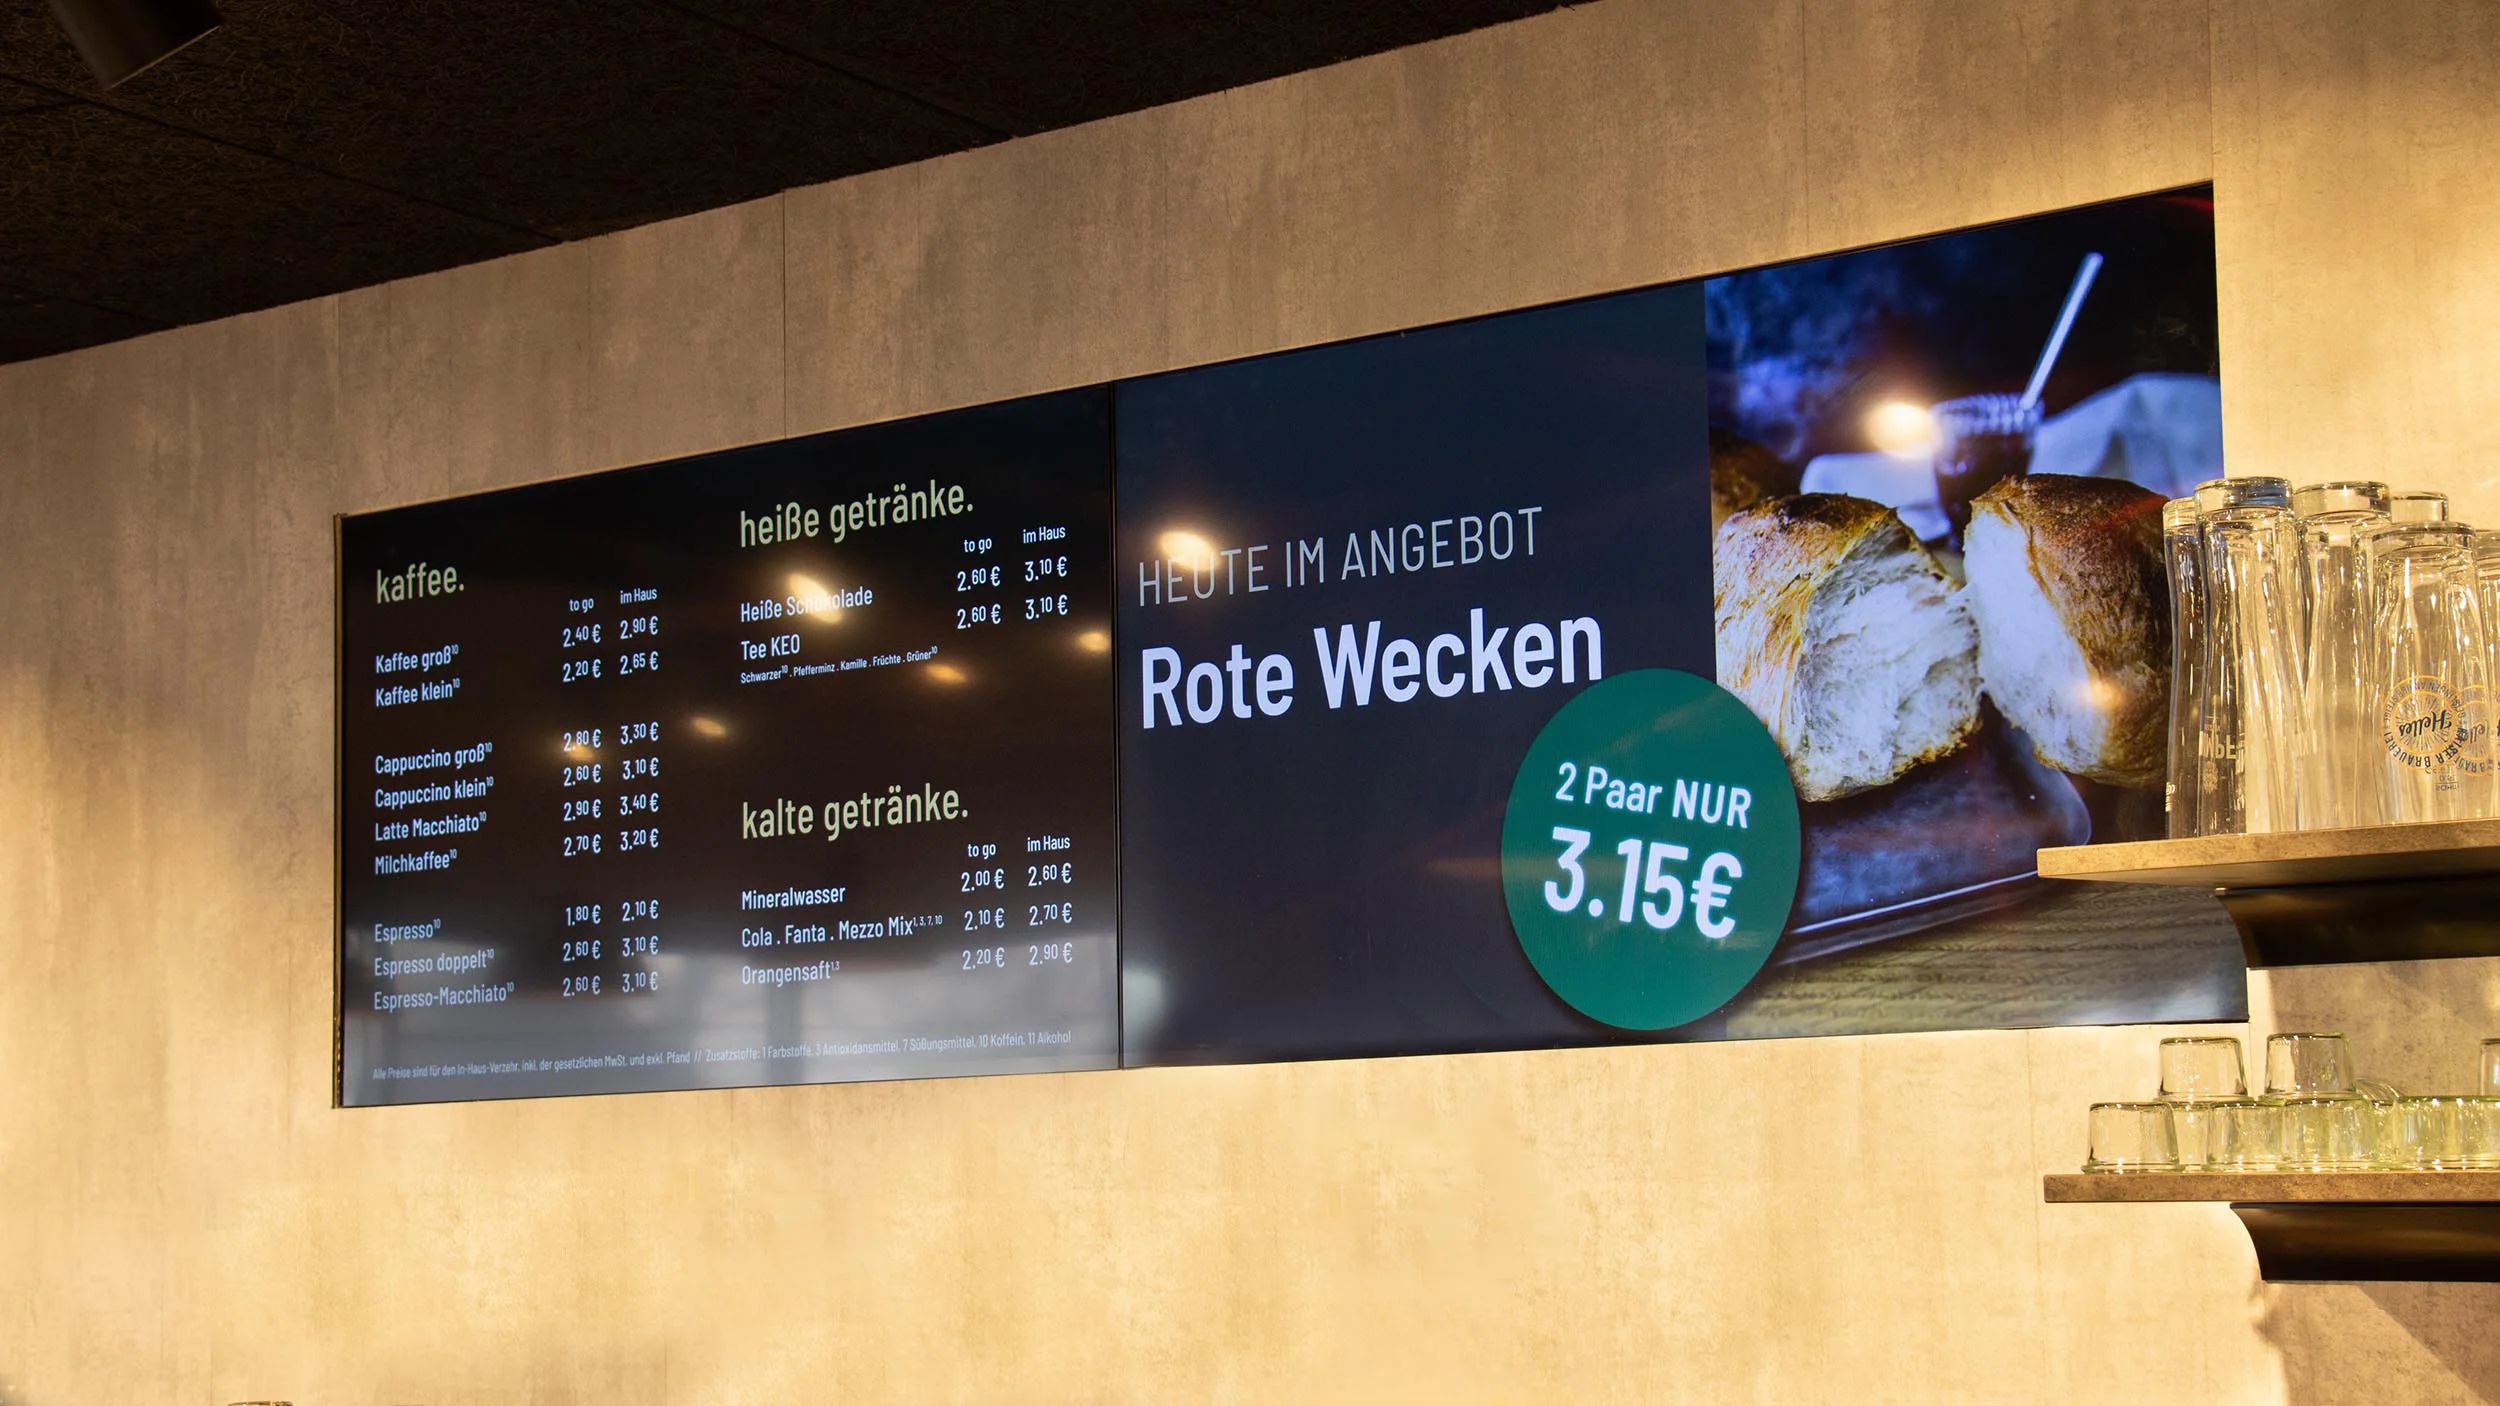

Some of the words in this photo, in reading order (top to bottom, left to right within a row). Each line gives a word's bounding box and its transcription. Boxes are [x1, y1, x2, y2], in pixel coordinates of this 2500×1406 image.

[740, 501, 820, 548] heiße
[830, 479, 974, 544] getränke.
[963, 539, 976, 553] to
[978, 537, 992, 554] go
[1022, 529, 1036, 544] im
[1038, 525, 1066, 542] Haus
[1139, 545, 1269, 607] HEUTE
[1286, 538, 1326, 588] IM
[1341, 506, 1543, 581] ANGEBOT
[957, 567, 987, 592] 2.60
[990, 566, 1001, 588] €
[1024, 558, 1052, 582] 3.10
[1056, 556, 1067, 578] €
[376, 562, 465, 604] kaffee.
[569, 599, 580, 612] to
[582, 597, 594, 613] go
[620, 590, 632, 604] im
[634, 587, 657, 602] Haus
[740, 600, 783, 623] Heiße
[786, 586, 873, 616] Schokolade
[1025, 596, 1053, 621] 3.10
[1057, 594, 1068, 616] €
[620, 617, 646, 640] 2.90
[649, 616, 658, 635] €
[957, 605, 987, 630] 2.60
[990, 603, 1001, 625] €
[563, 625, 589, 648] 2.40
[592, 624, 601, 643] €
[740, 639, 767, 661] Tee
[771, 634, 801, 657] KEO
[375, 651, 418, 674] Kaffee
[563, 660, 589, 682] 2.20
[592, 659, 601, 678] €
[620, 652, 646, 675] 2.65
[649, 651, 658, 671] €
[793, 661, 835, 678] Pfefferminz
[840, 657, 868, 672] Kamille
[872, 652, 901, 668] Früchte
[1141, 643, 1294, 729] Rote
[1314, 607, 1603, 709] Wecken
[375, 685, 418, 707] Kaffee
[620, 723, 647, 745] 3.30
[649, 721, 659, 741] €
[2399, 710, 2453, 738] Helles
[563, 730, 589, 752] 2.80
[592, 729, 601, 748] €
[2384, 731, 2431, 769] BRAUEREI
[375, 748, 451, 776] Cappuccino
[622, 758, 647, 781] 3.10
[649, 757, 659, 777] €
[563, 765, 589, 787] 2.60
[592, 764, 601, 783] €
[375, 782, 451, 810] Cappuccino
[620, 794, 647, 816] 3.40
[649, 793, 659, 813] €
[1555, 761, 1576, 802] 2
[1584, 766, 1662, 815] Paar
[1672, 778, 1752, 829] NUR
[563, 800, 589, 822] 2.90
[592, 799, 601, 818] €
[743, 799, 813, 840] kalte
[824, 783, 968, 841] getränke.
[375, 820, 409, 842] Latte
[620, 830, 647, 851] 3.20
[649, 828, 659, 848] €
[563, 835, 589, 857] 2.70
[592, 834, 601, 853] €
[968, 844, 979, 857] to
[982, 842, 996, 859] go
[1027, 837, 1040, 852] im
[1043, 835, 1070, 850] Haus
[961, 870, 990, 892] 2.00
[994, 868, 1004, 889] €
[1028, 864, 1057, 887] 2.60
[1062, 862, 1072, 884] €
[1544, 825, 1744, 940] 3.15€
[742, 885, 845, 910] Mineralwasser
[566, 906, 589, 926] 1.80
[592, 904, 601, 925] €
[622, 901, 647, 922] 2.10
[649, 900, 659, 919] €
[964, 909, 990, 931] 2.10
[994, 907, 1005, 928] €
[1029, 904, 1058, 926] 2.70
[1062, 902, 1072, 923] €
[742, 926, 772, 947] Cola
[785, 922, 826, 944] Fanta
[839, 919, 884, 941] Mezzo
[563, 941, 589, 962] 2.60
[592, 940, 601, 959] €
[622, 937, 647, 957] 3.10
[649, 936, 659, 955] €
[1029, 944, 1058, 966] 2.90
[1062, 942, 1073, 963] €
[374, 957, 433, 979] Espresso
[962, 949, 991, 971] 2.20
[995, 947, 1005, 968] €
[563, 977, 589, 997] 2.60
[592, 975, 601, 995] €
[622, 973, 647, 992] 3.10
[649, 972, 659, 991] €
[429, 1065, 440, 1077] für
[442, 1064, 456, 1076] den
[539, 1058, 552, 1071] der
[554, 1056, 603, 1073] gesetzlichen
[604, 1054, 627, 1068] MwSt.
[630, 1053, 645, 1066] und
[667, 1051, 691, 1064] Pfand
[979, 1035, 988, 1048] 10
[1028, 1031, 1035, 1045] 11
[1037, 1030, 1072, 1045] Alkohol
